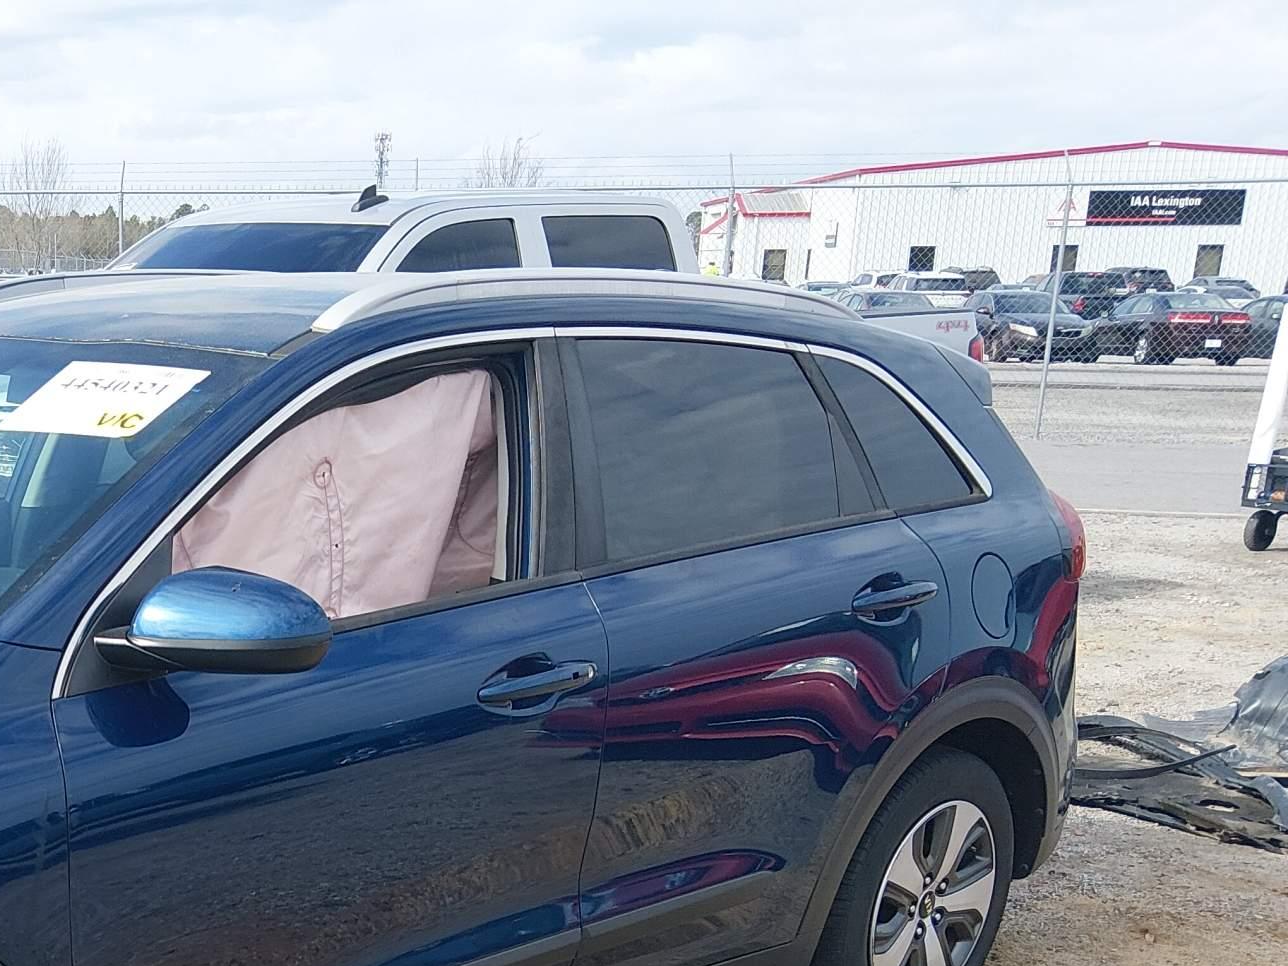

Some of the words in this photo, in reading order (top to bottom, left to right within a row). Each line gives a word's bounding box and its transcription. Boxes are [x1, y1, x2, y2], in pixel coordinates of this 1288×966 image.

[1130, 196, 1150, 207] IAA
[1152, 196, 1202, 208] Lexington
[60, 378, 169, 395] 44540321
